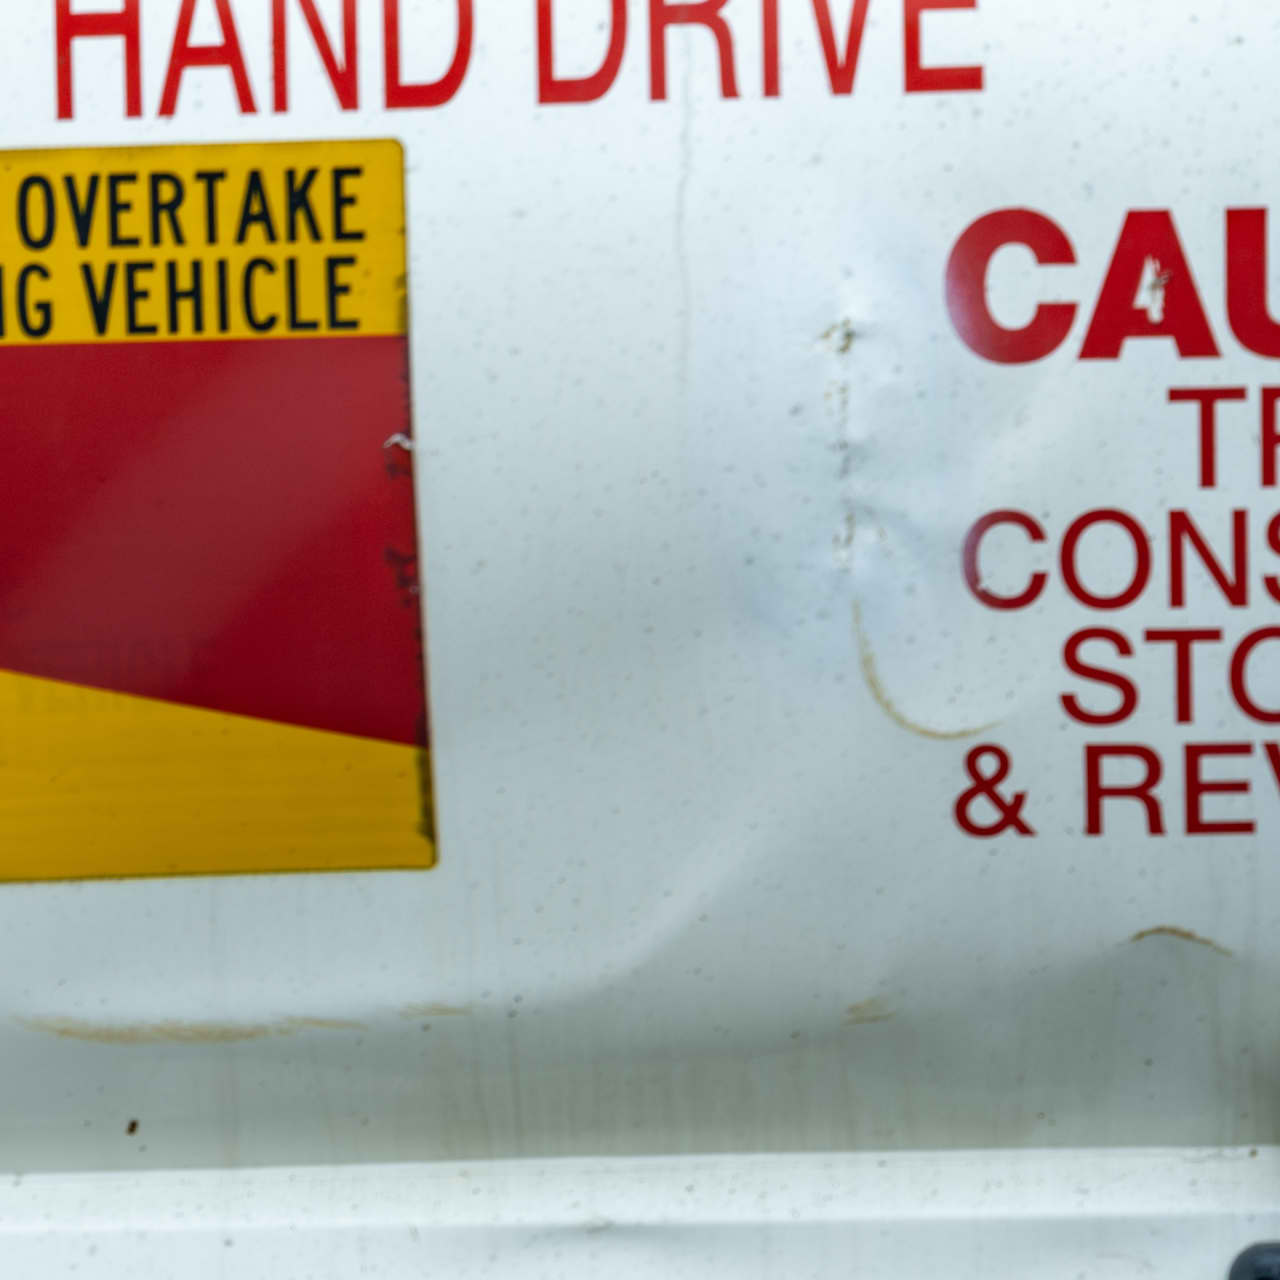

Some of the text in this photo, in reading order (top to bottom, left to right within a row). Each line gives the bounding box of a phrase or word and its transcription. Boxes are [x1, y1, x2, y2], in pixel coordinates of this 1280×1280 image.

[55, 0, 474, 120] HAND
[536, 0, 984, 104] DRIVE
[18, 167, 365, 251] OVERTAKE
[81, 256, 360, 336] VEHICLE
[1167, 386, 1280, 489] T
[963, 508, 1280, 611] CON
[953, 742, 1280, 838] & RE
